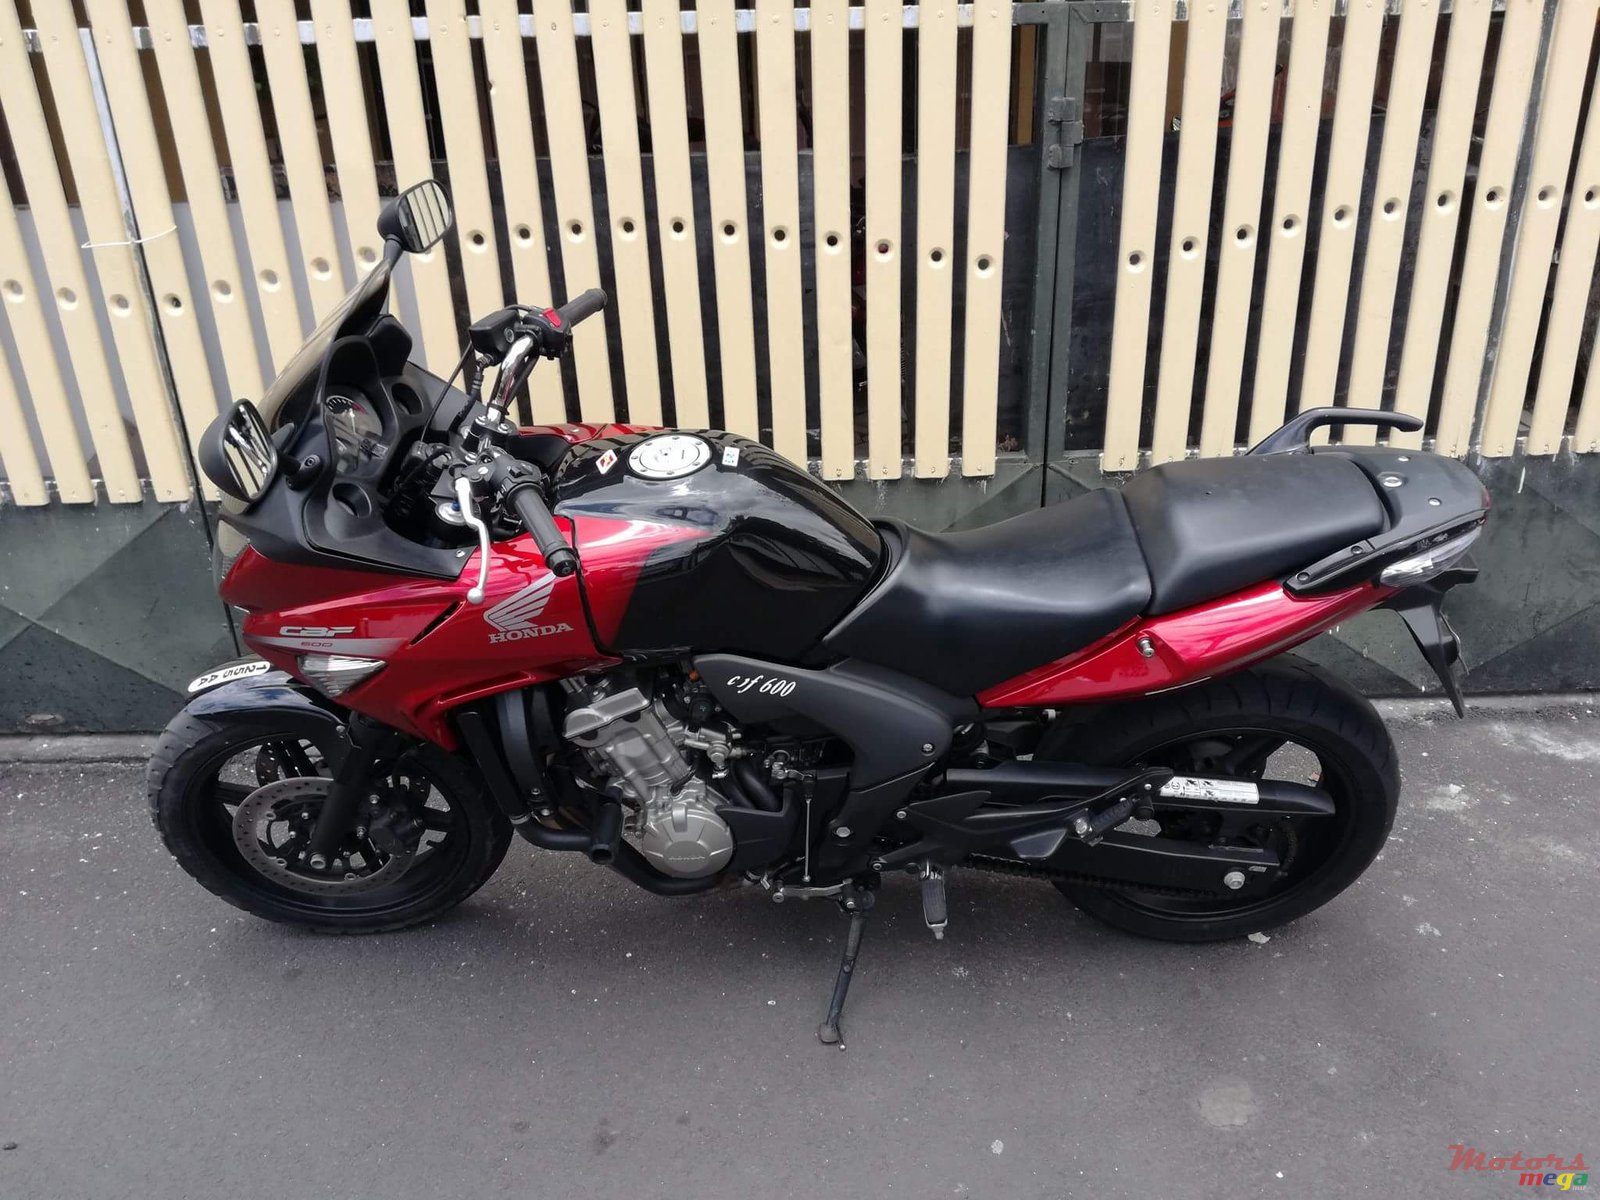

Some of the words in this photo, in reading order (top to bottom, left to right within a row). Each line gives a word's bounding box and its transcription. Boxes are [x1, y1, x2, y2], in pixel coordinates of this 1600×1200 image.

[279, 626, 356, 637] CBF
[488, 622, 574, 643] HONDA
[759, 677, 797, 697] 600
